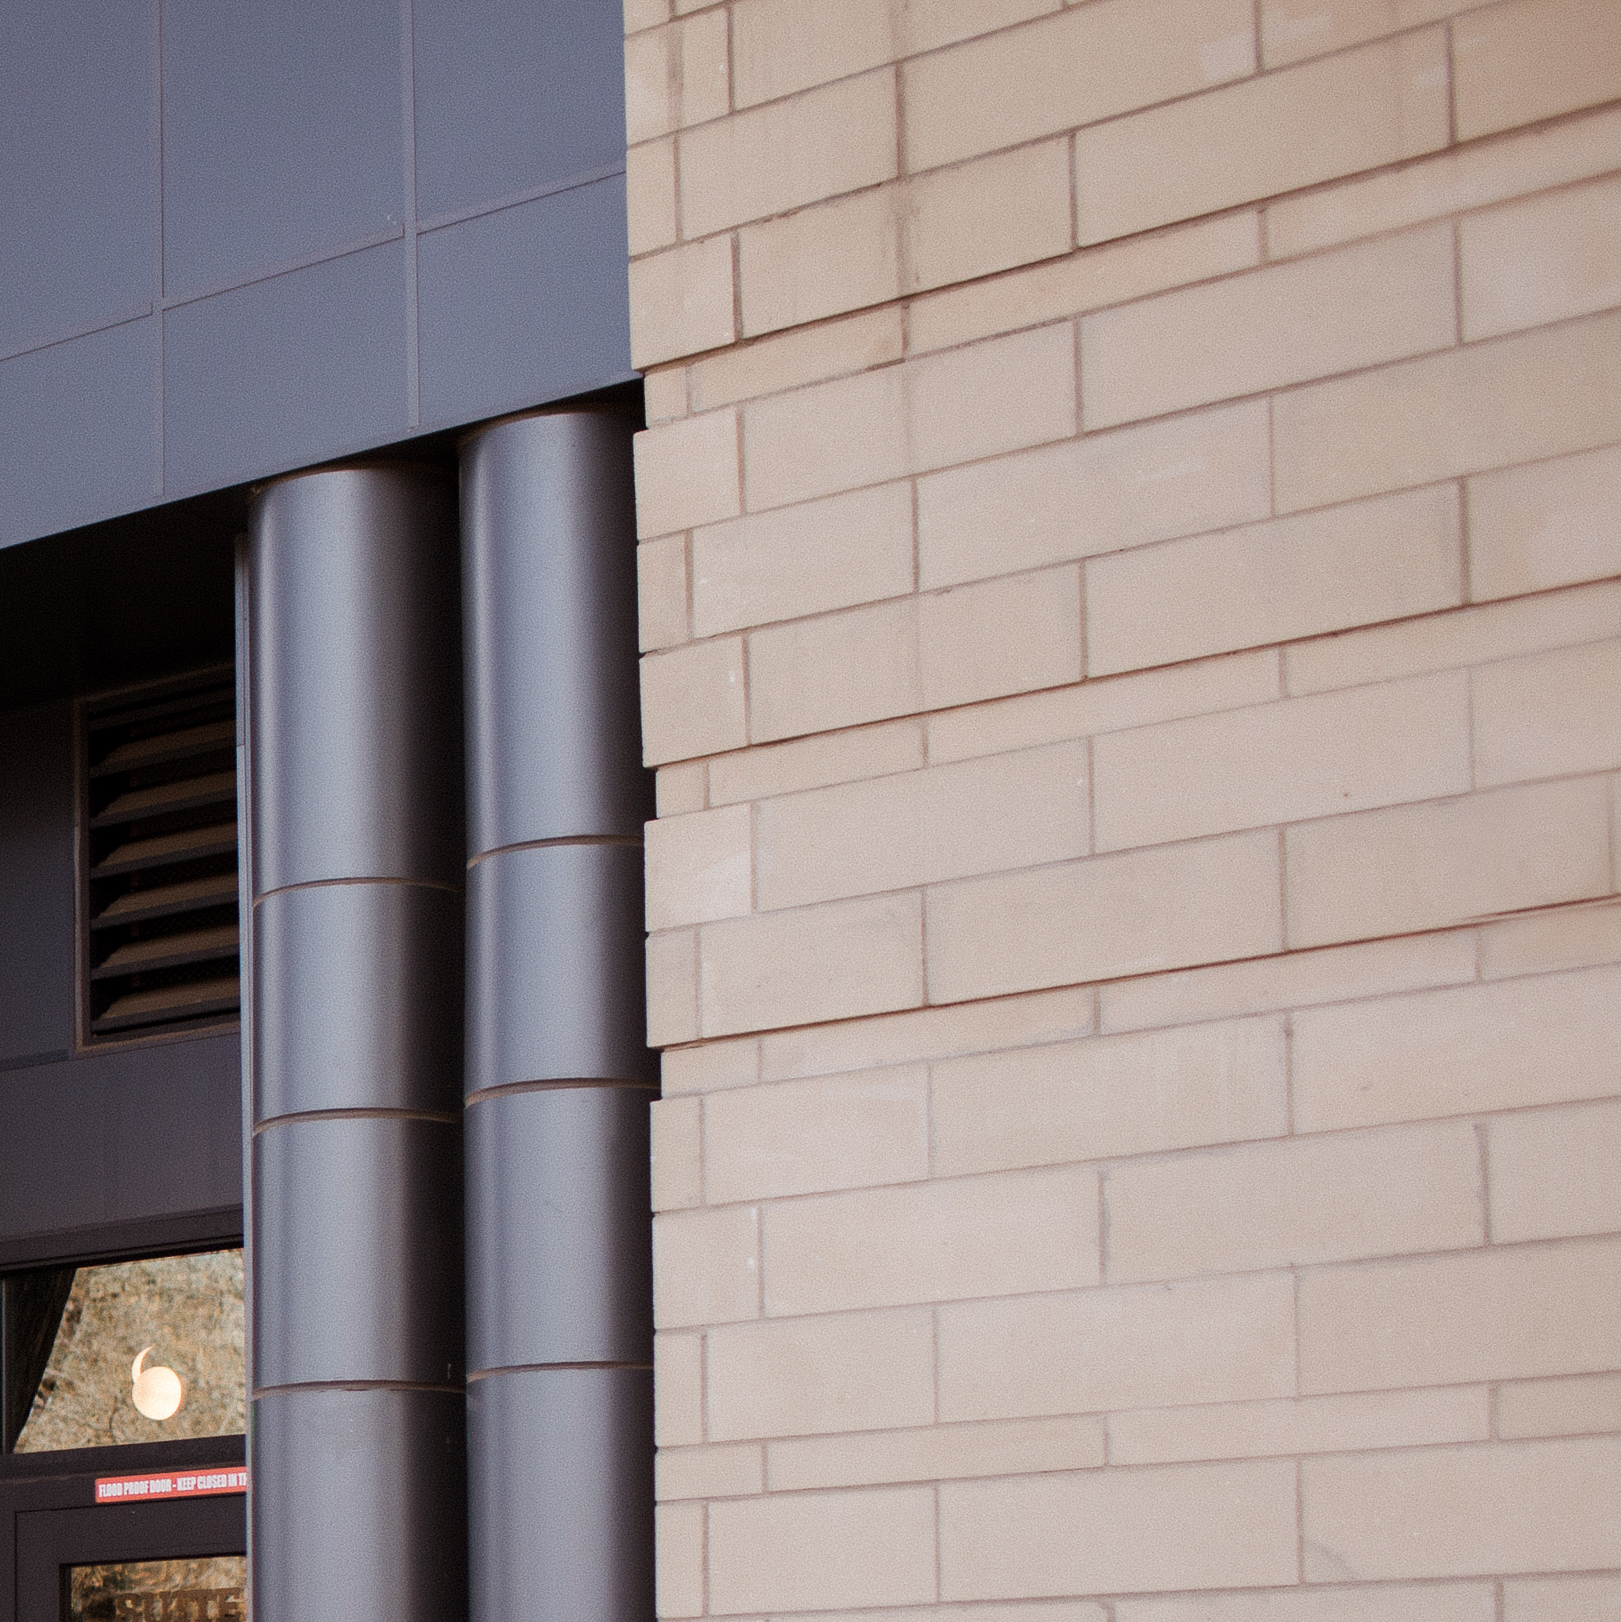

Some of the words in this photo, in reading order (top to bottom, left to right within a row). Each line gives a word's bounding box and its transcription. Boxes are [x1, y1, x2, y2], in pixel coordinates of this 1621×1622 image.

[98, 1482, 123, 1498] FLOOD
[123, 1480, 150, 1496] PROOF
[149, 1478, 172, 1494] DOOR
[177, 1476, 197, 1492] KEEP
[197, 1475, 227, 1490] CLOSED
[228, 1473, 238, 1487] IN
